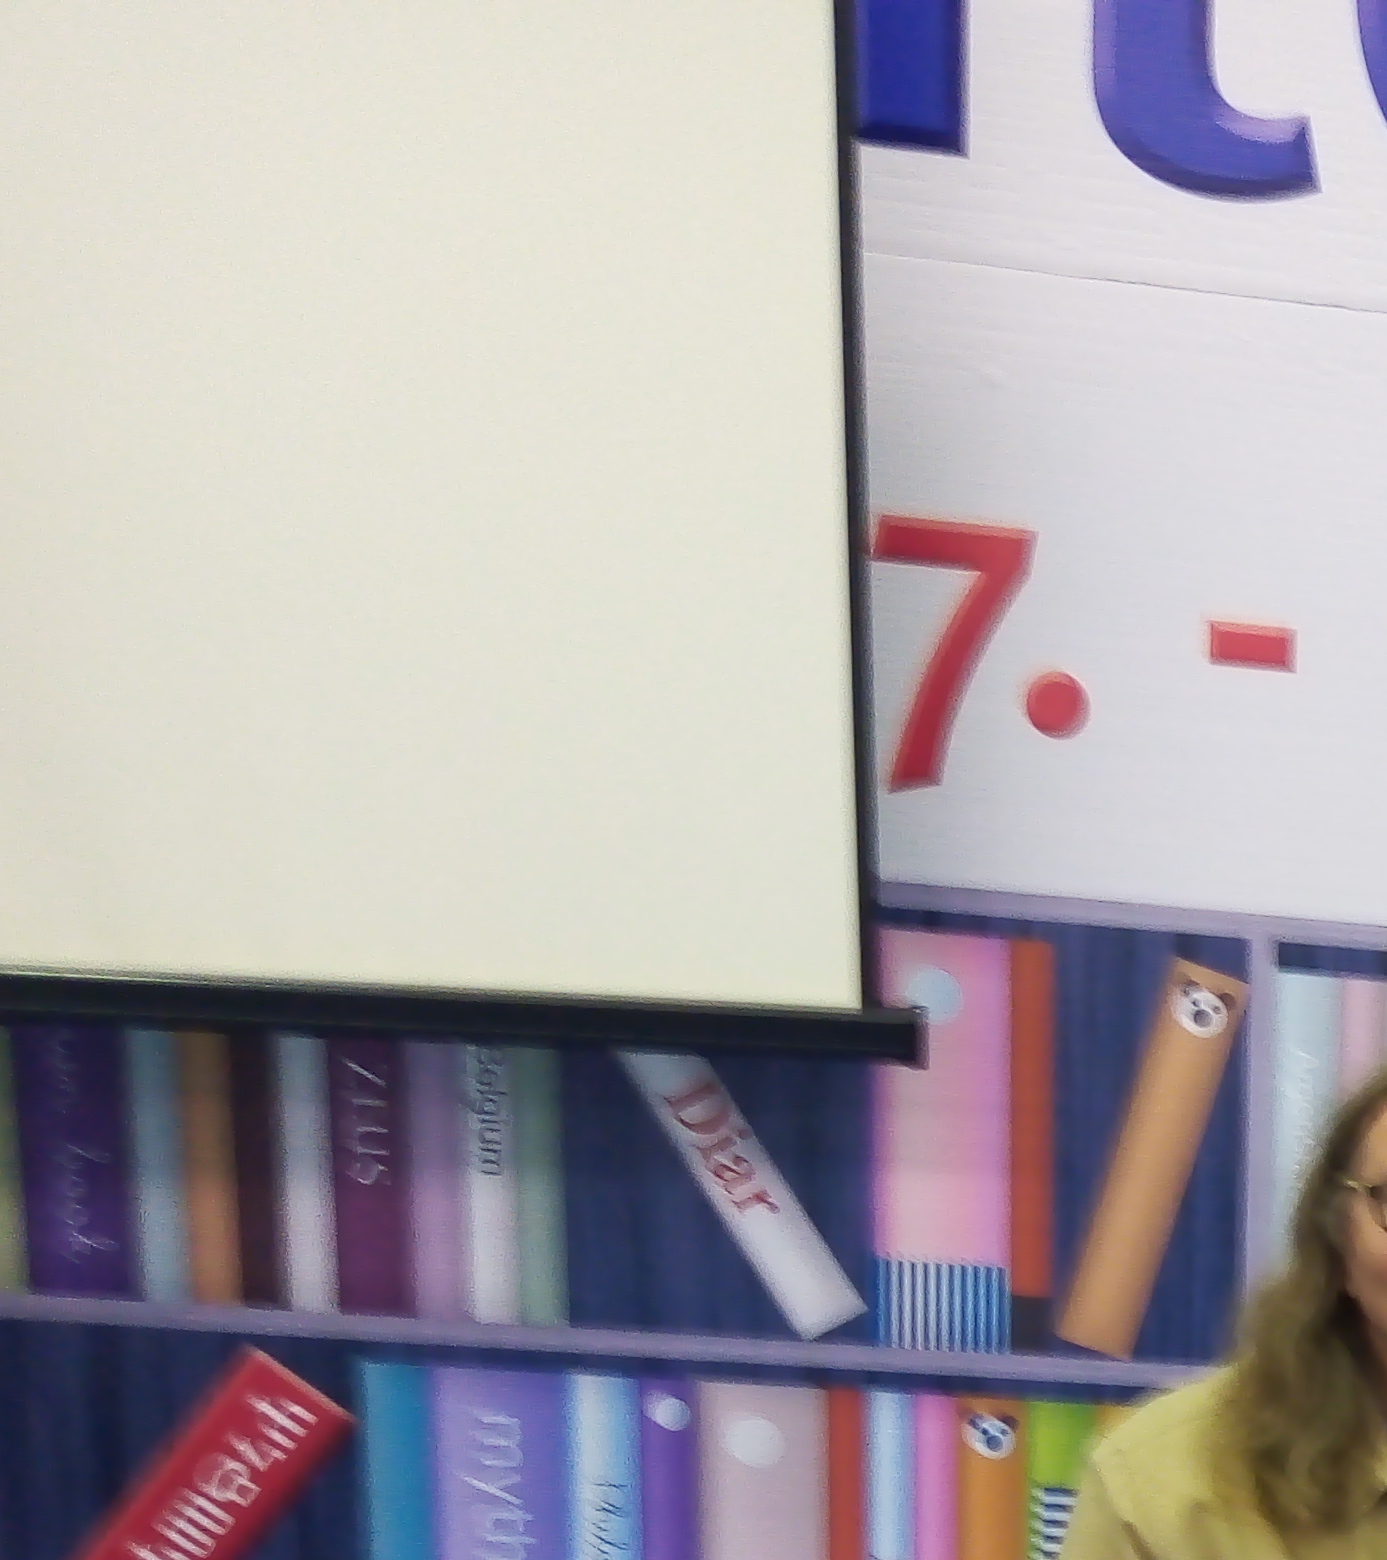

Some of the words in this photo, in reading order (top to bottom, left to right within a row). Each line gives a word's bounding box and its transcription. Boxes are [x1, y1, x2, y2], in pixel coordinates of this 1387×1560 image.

[868, 510, 1092, 797] 7.
[1205, 616, 1298, 676] -
[663, 1081, 781, 1216] Diar
